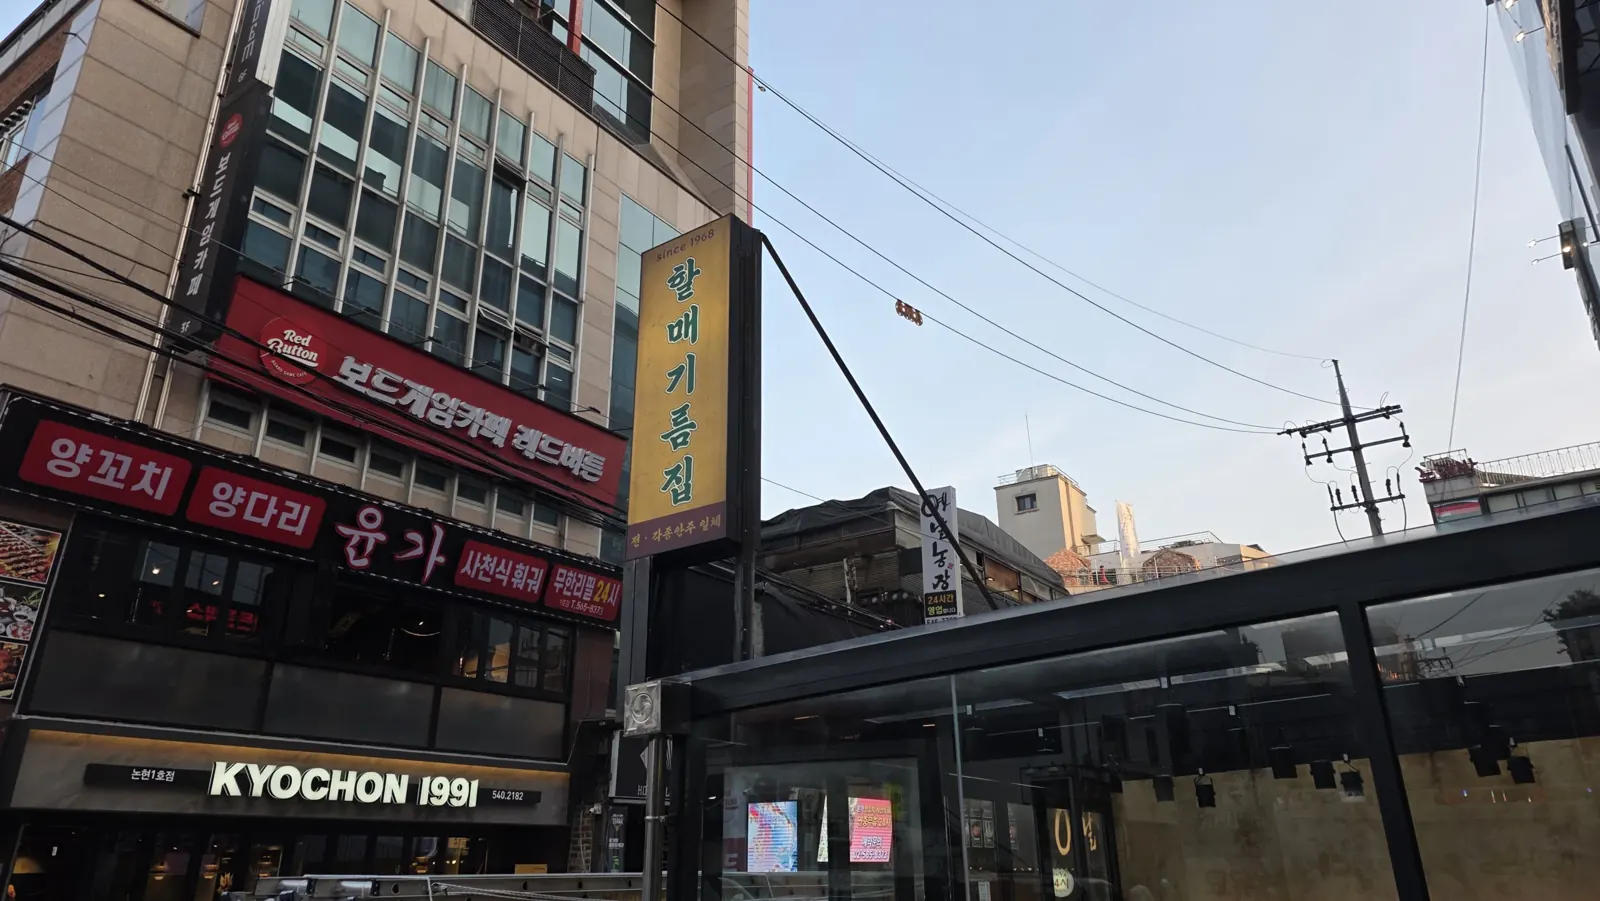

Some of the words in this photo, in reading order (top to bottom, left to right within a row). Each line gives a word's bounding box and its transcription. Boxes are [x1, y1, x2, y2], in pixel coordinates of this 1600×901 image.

[186, 152, 231, 295] 보드게임카페
[656, 243, 686, 262] since
[690, 228, 715, 247] 1968
[283, 329, 312, 346] Red
[659, 256, 702, 506] 할매기름집
[332, 355, 512, 448] 보드게임카페
[512, 424, 606, 482] 레드버튼
[46, 438, 173, 500] 양꼬치
[208, 482, 311, 536] 양다리
[652, 521, 696, 542] 각종안주
[460, 550, 513, 587] 사천식
[513, 562, 544, 594] 훠궈
[553, 568, 596, 601] 무한리필
[594, 580, 620, 606] 24시
[927, 593, 954, 604] 24시간
[131, 768, 175, 782] 논현1호점
[208, 761, 409, 804] KYOCHON
[418, 776, 479, 807] 1991
[492, 790, 524, 800] 540.2182
